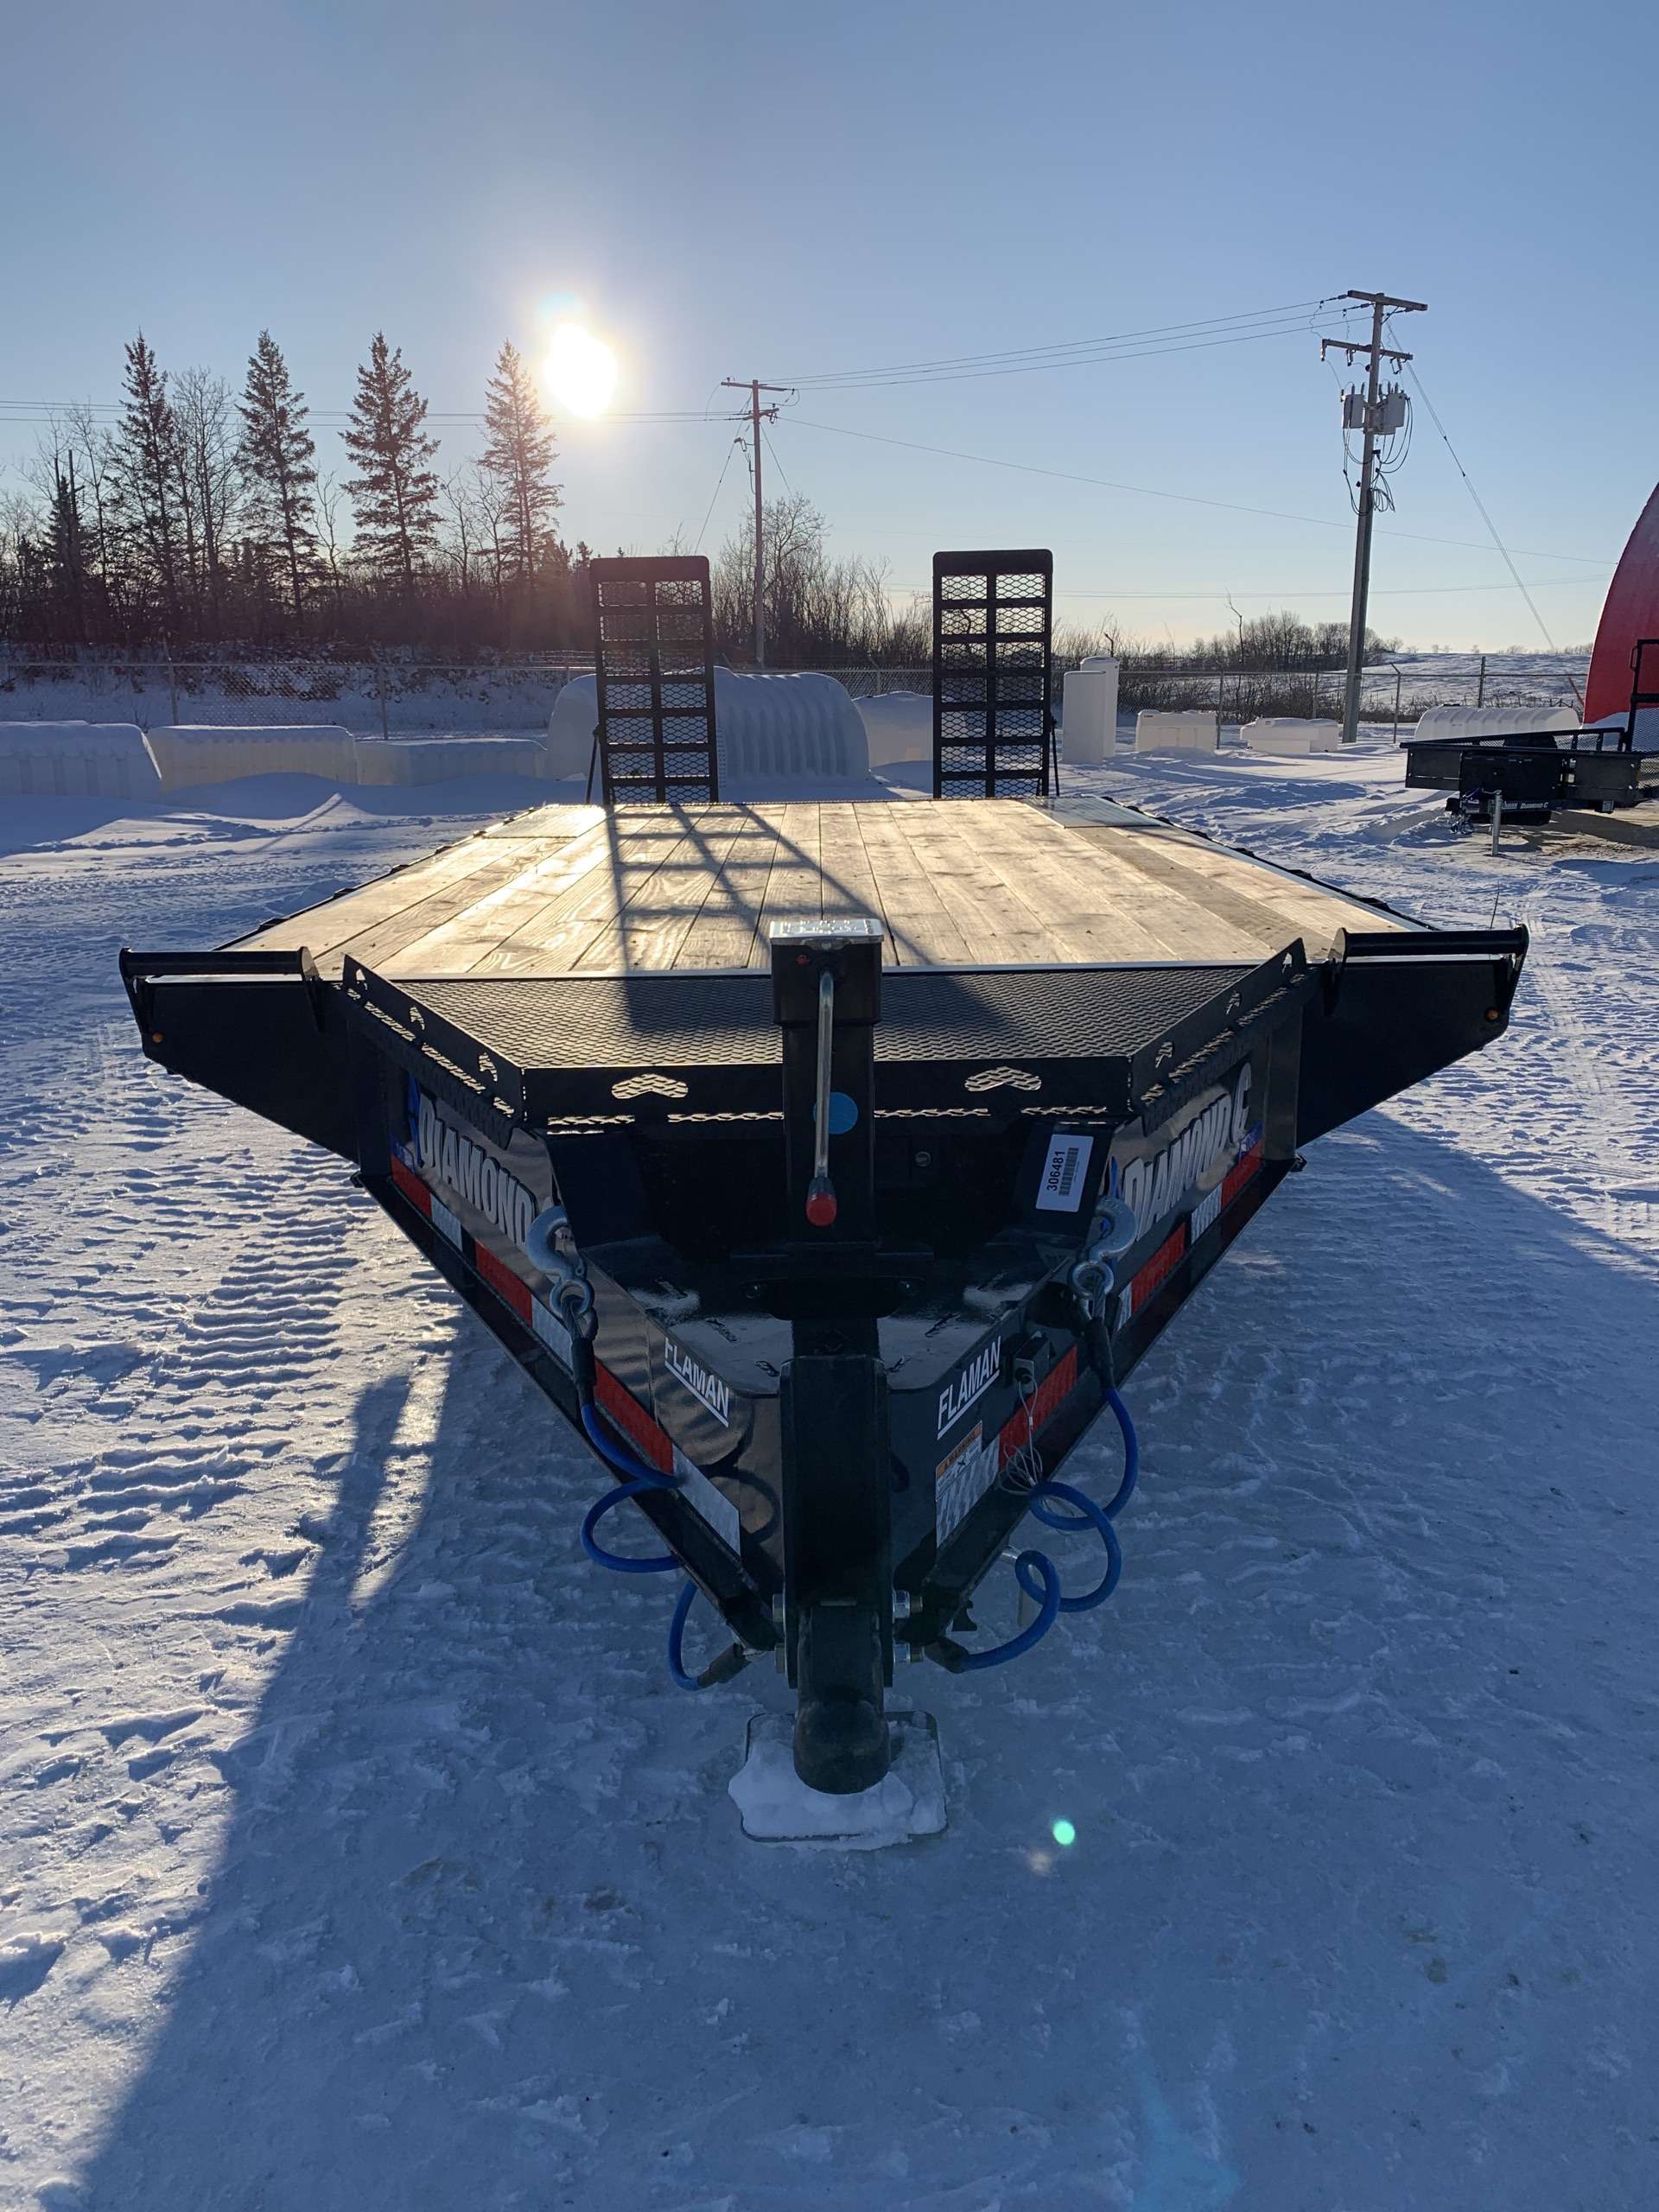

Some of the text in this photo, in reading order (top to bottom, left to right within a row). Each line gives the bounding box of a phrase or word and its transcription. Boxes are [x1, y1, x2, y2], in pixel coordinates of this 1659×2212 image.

[418, 1092, 536, 1247] DIAMOND
[1046, 1151, 1065, 1191] 306481
[1122, 1093, 1231, 1242] DIAMOND
[664, 1337, 729, 1420] FLAMAN
[938, 1335, 1001, 1431] FLAMAN
